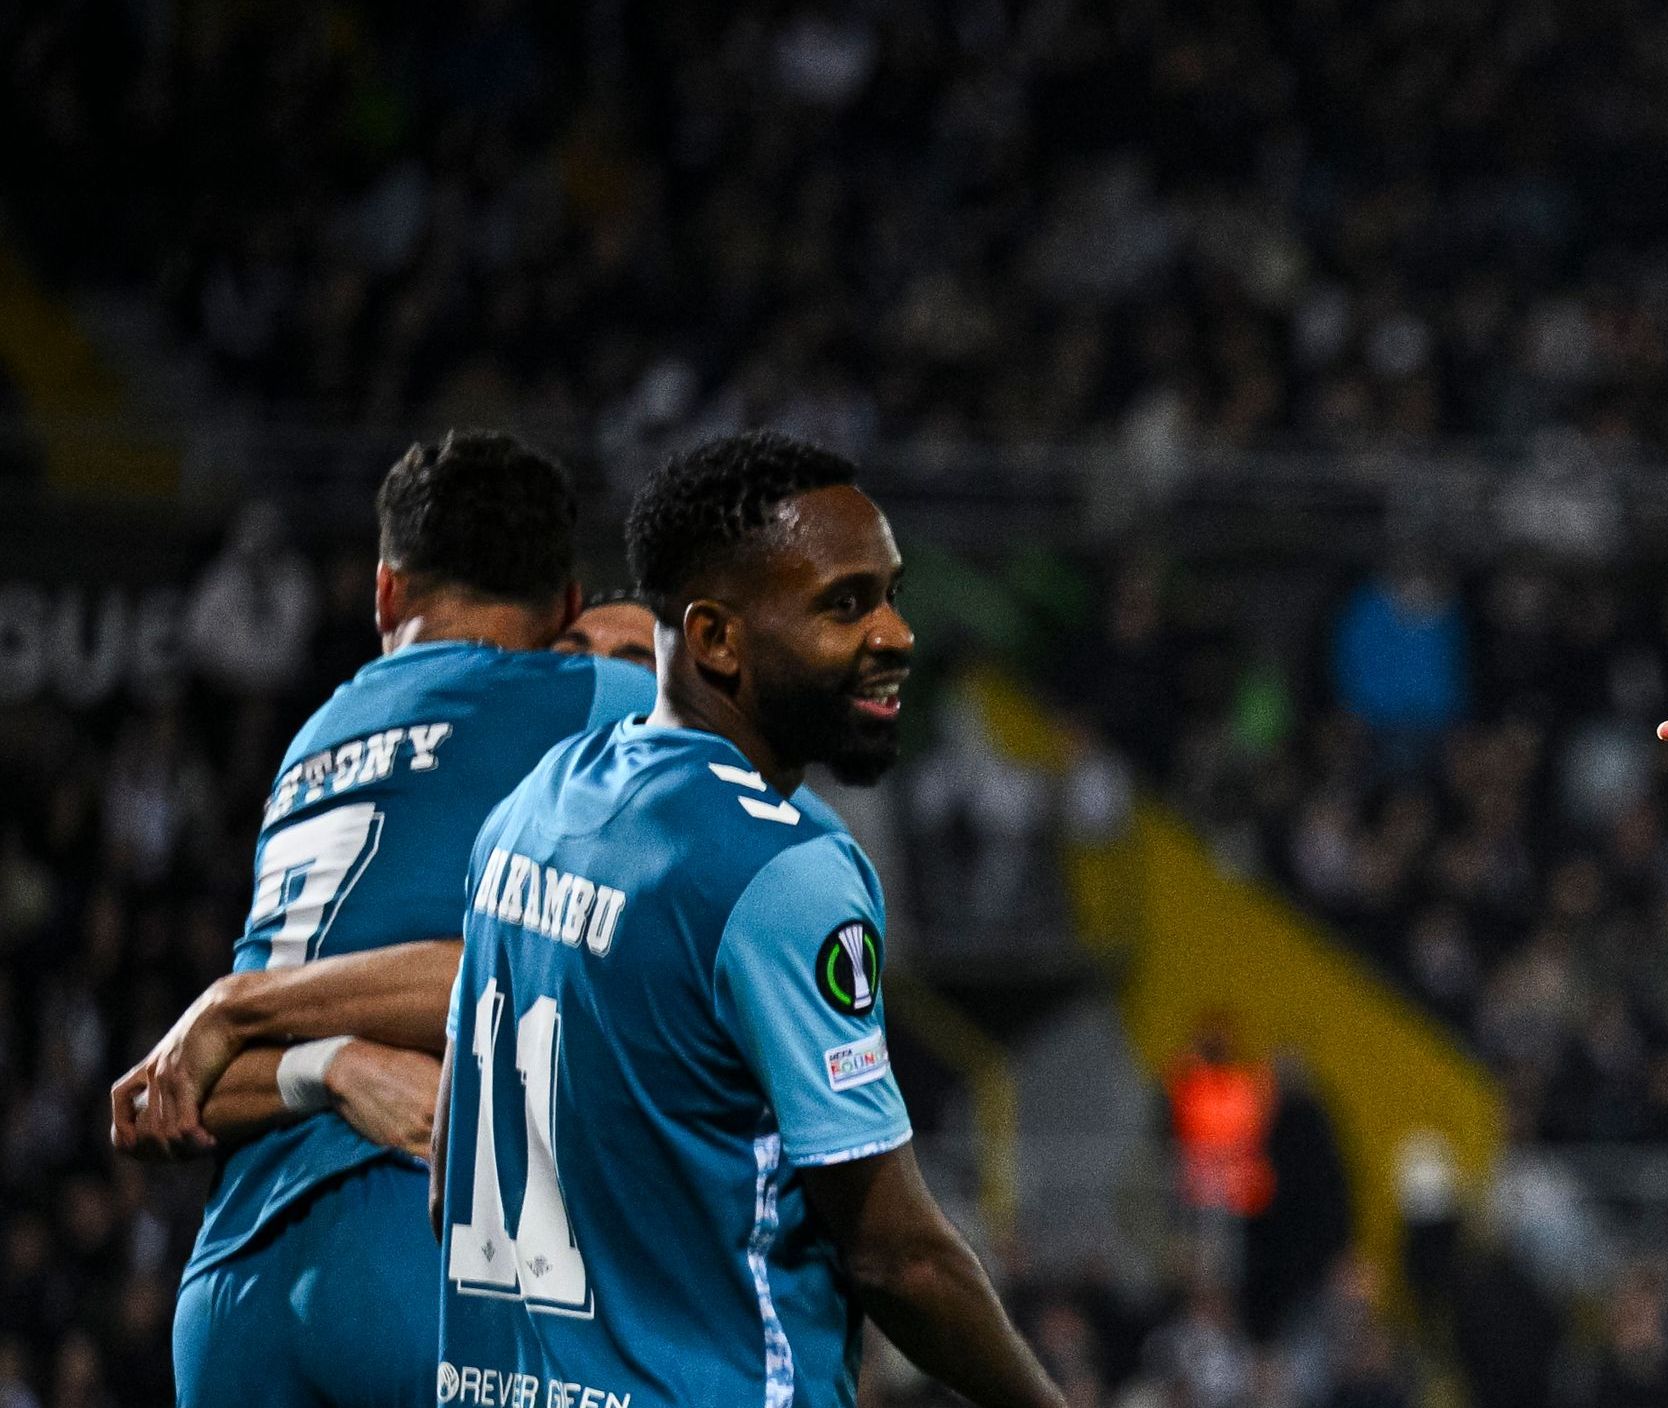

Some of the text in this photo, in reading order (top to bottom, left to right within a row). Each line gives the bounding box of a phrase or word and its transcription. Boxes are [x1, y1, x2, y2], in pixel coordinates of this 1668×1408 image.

[251, 802, 386, 970] 7
[474, 848, 627, 958] AKAMBU
[448, 977, 595, 1320] 11
